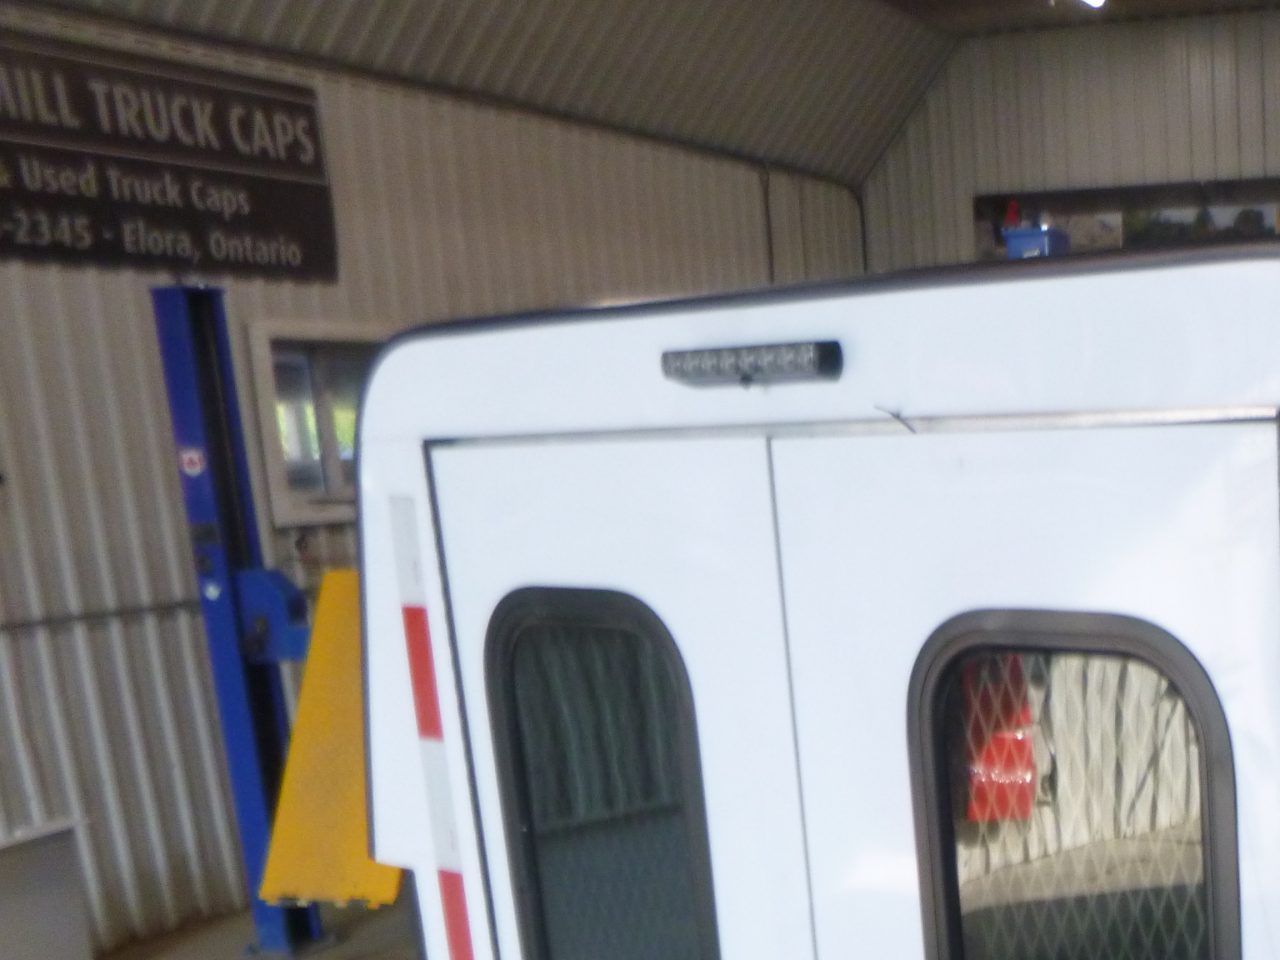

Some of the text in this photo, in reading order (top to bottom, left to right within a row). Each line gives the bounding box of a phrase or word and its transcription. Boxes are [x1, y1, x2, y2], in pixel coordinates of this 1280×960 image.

[87, 78, 221, 150] TRUCK
[228, 103, 315, 165] CAPS
[18, 154, 98, 199] Used
[106, 163, 184, 209] Truck
[190, 180, 251, 221] Caps
[209, 230, 303, 267] Ontario
